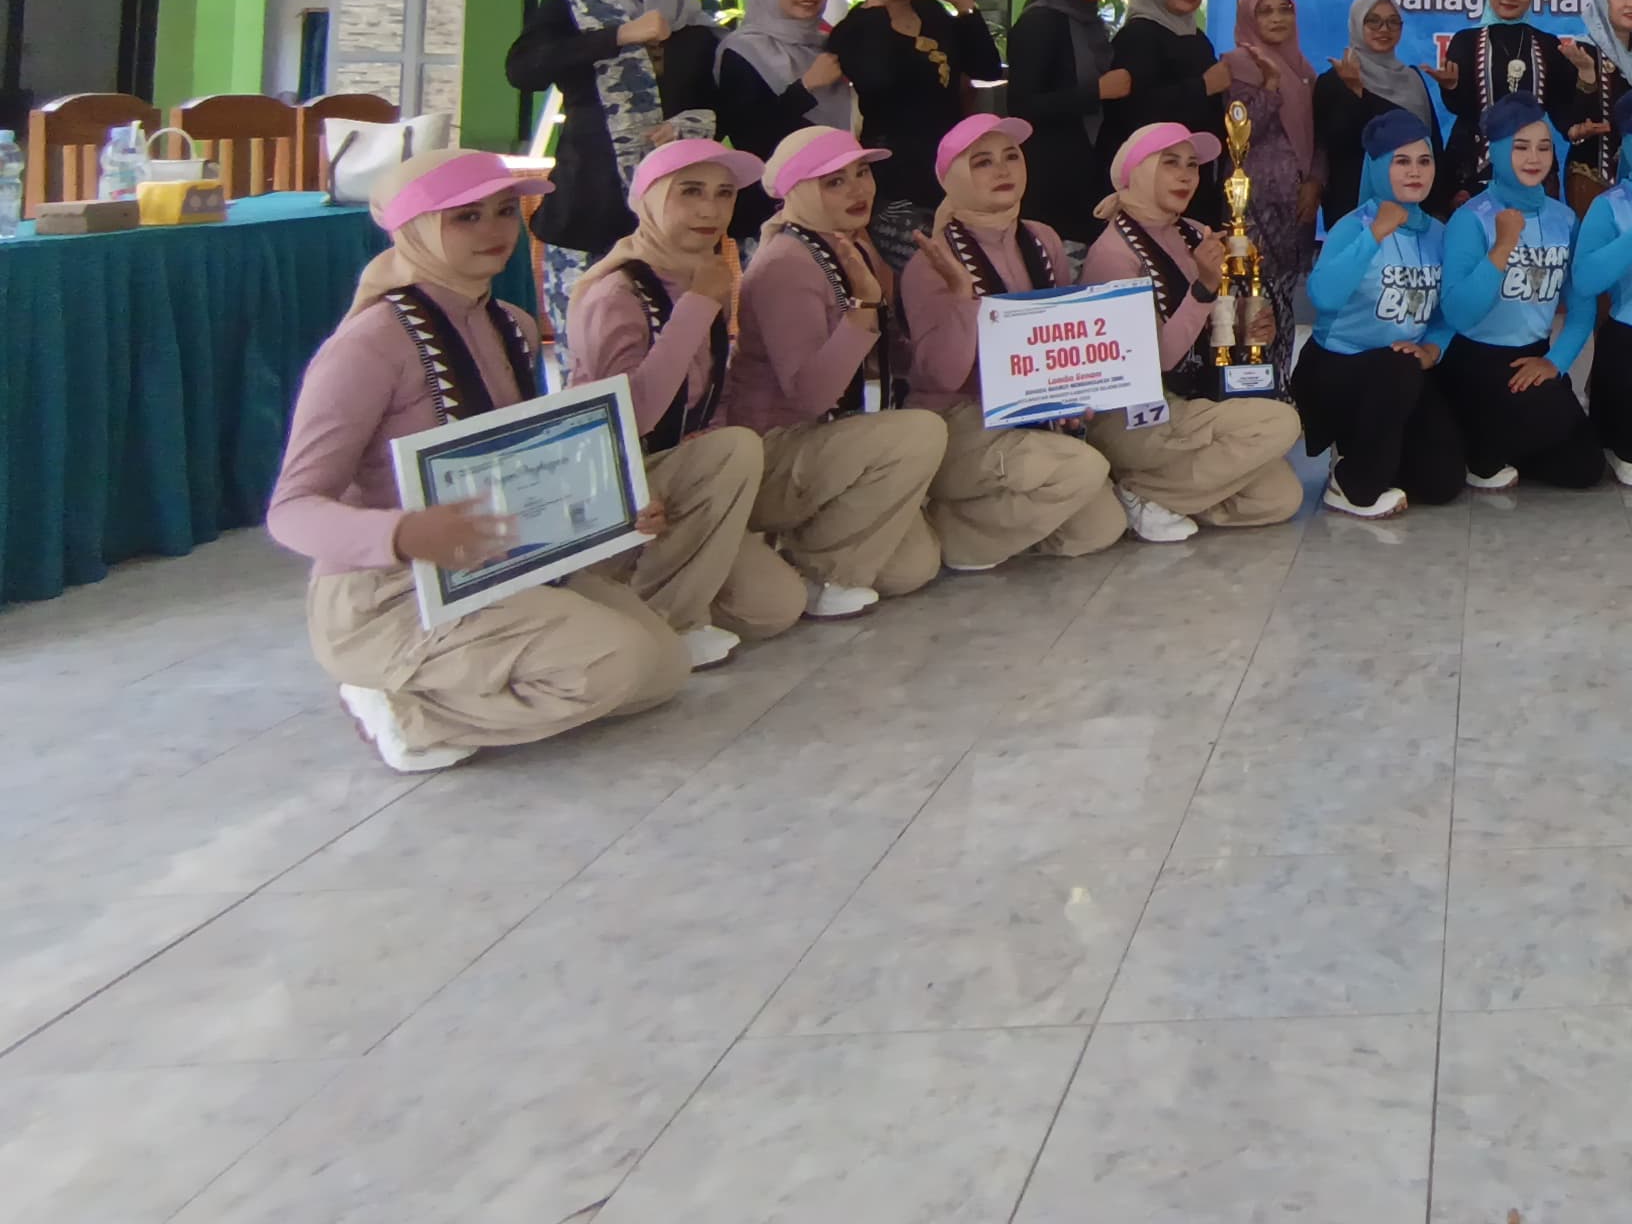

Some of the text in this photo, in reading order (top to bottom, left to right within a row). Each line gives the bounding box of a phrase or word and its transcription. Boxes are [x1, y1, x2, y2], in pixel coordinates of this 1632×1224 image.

[1026, 317, 1107, 346] JUARA 2
[1010, 339, 1133, 377] Rp. 500.000,-
[1132, 405, 1166, 427] 17
